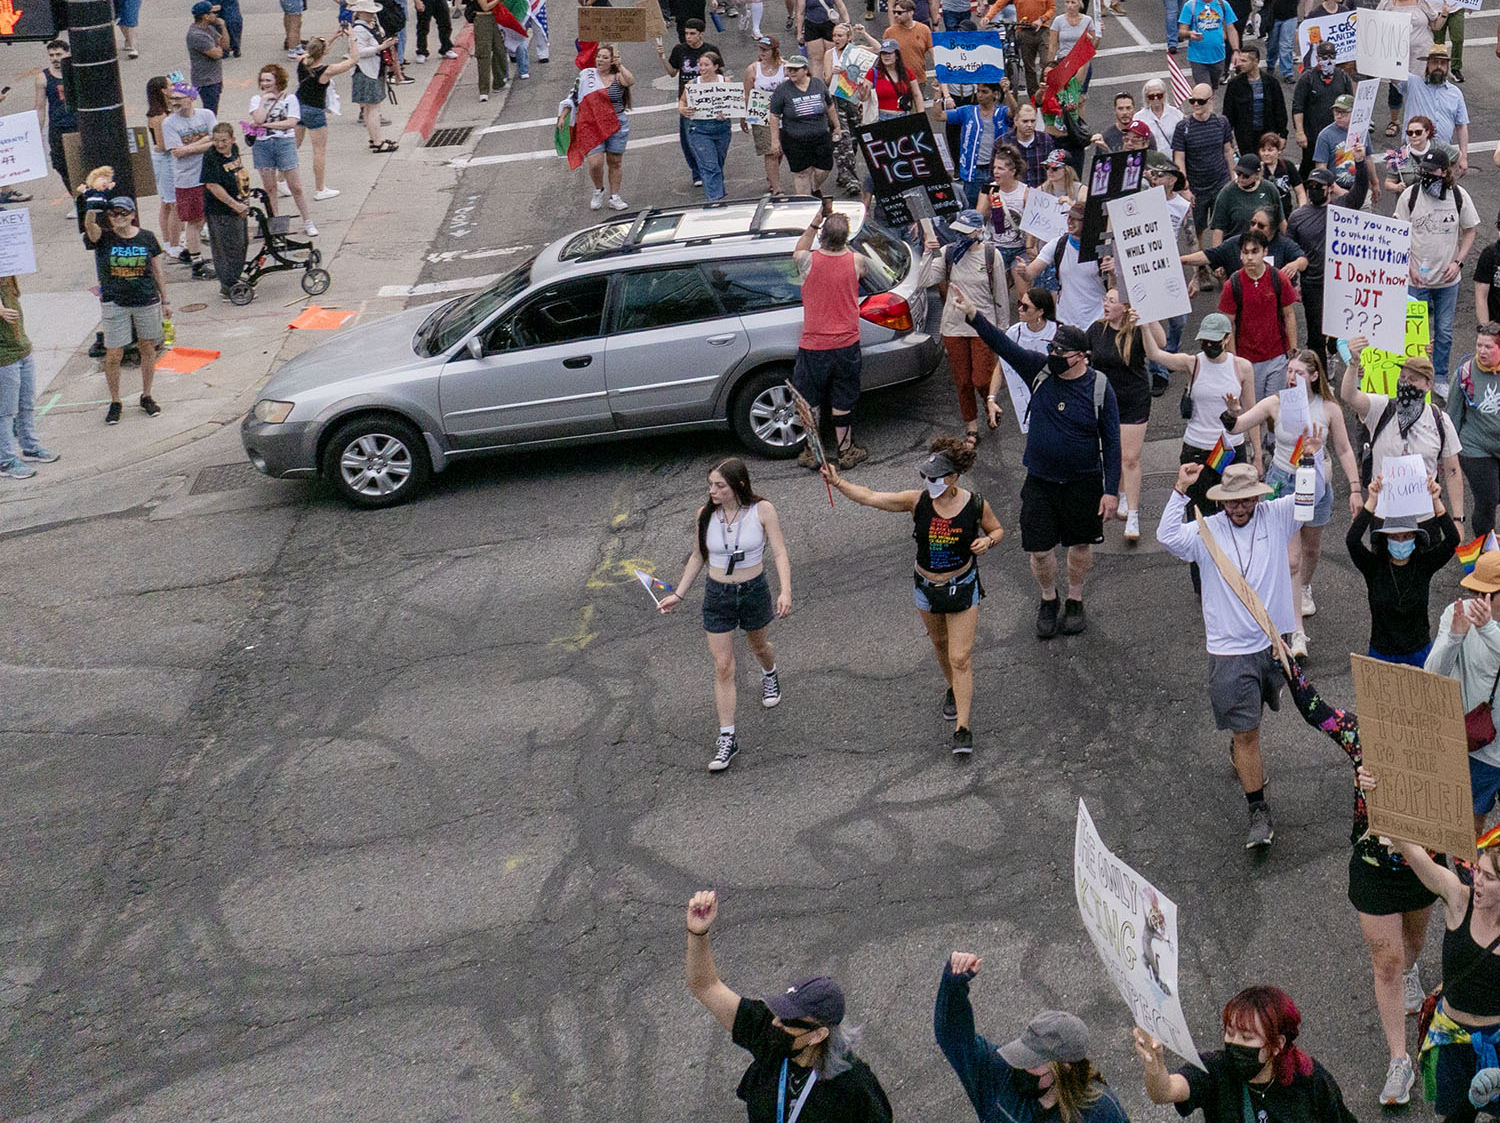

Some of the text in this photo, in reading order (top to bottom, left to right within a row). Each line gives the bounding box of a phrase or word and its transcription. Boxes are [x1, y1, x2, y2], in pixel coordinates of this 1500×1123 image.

[950, 39, 977, 50] Brown
[867, 132, 932, 169] FUCK
[883, 156, 930, 183] ICE
[1122, 221, 1159, 242] SPEAK OUT
[1333, 227, 1394, 247] to uphold the
[1363, 219, 1386, 235] you
[1386, 225, 1411, 239] need
[111, 245, 148, 257] PEACE
[1126, 239, 1163, 259] WHILE YOU
[1133, 258, 1171, 278] STILL CAN!
[1347, 262, 1377, 286] Don't
[1342, 307, 1384, 337] ???
[1361, 663, 1456, 719] RETURN
[1375, 705, 1447, 753] POWER
[1373, 742, 1438, 773] TO THE
[1371, 772, 1465, 827] PEOPLE!
[1095, 850, 1138, 916] ONLY
[1081, 879, 1137, 971] KING
